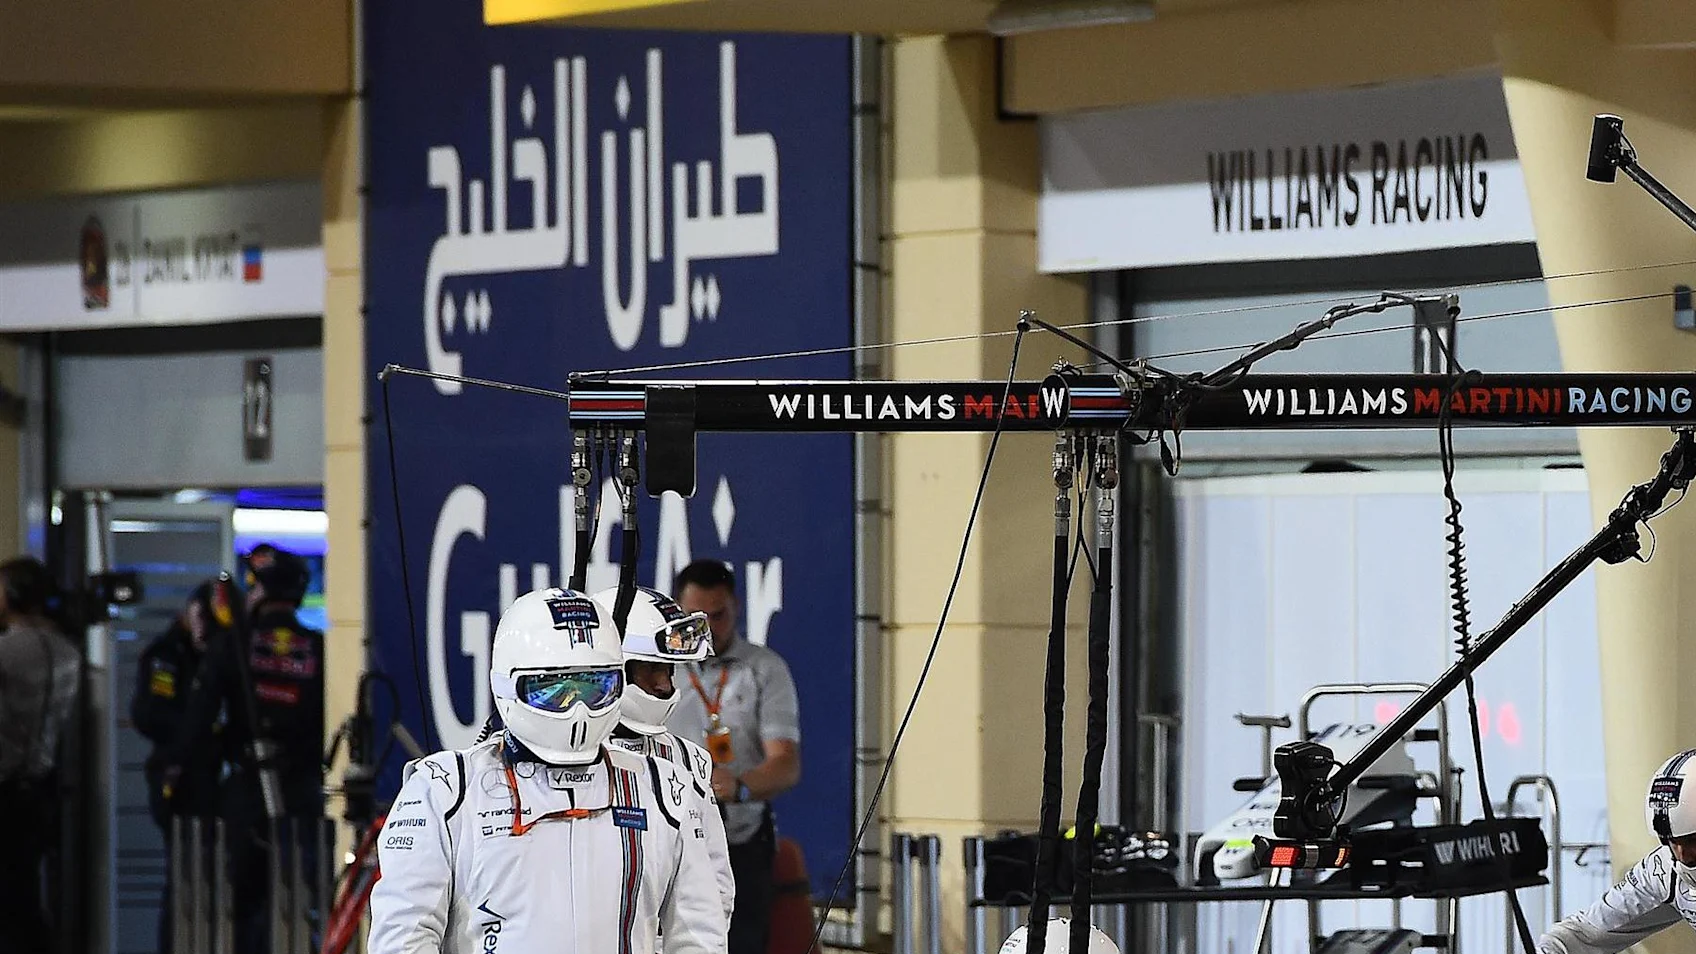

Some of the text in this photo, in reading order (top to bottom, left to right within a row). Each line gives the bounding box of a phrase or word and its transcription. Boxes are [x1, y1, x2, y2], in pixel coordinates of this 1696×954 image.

[1207, 132, 1488, 233] WILLIAMS RACING
[424, 40, 779, 396] طيران الخليج
[768, 393, 957, 420] WILLIAMS
[1041, 387, 1066, 419] W
[1243, 386, 1694, 416] WILLIAMS MARTINI RACING
[426, 474, 784, 752] Glf Ar
[397, 818, 427, 828] WIHURI
[491, 806, 532, 817] randad
[387, 836, 414, 847] ORIS
